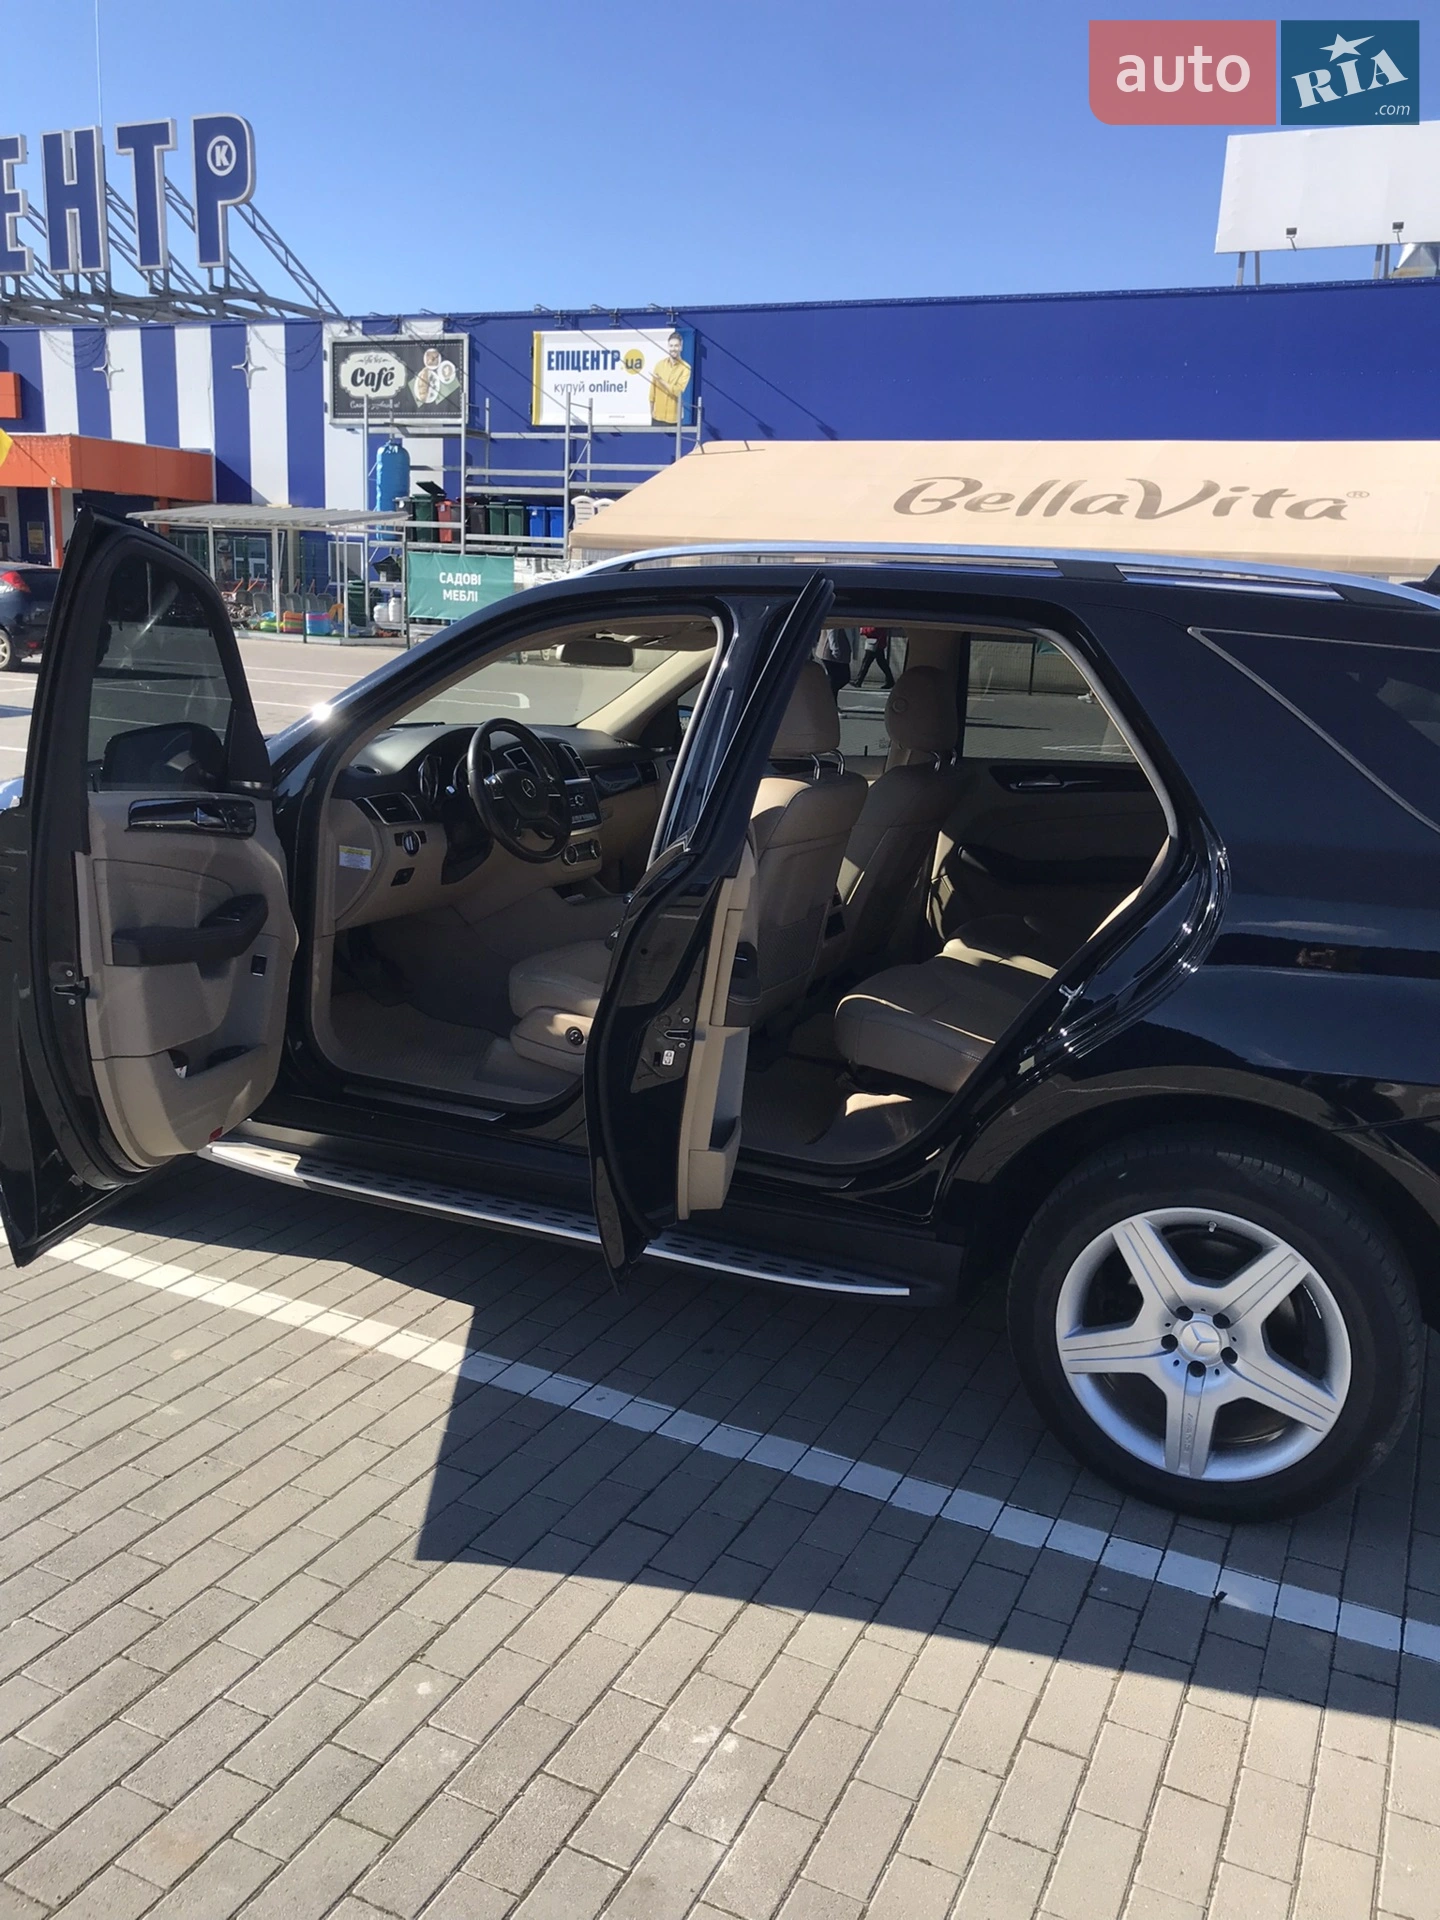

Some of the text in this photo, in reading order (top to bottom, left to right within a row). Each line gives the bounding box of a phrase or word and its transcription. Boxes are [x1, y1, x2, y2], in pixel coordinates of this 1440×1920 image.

[351, 367, 395, 392] Café
[554, 380, 628, 395] купуй online!
[440, 572, 481, 586] САДОВІ
[443, 589, 478, 602] МЕБЛІ
